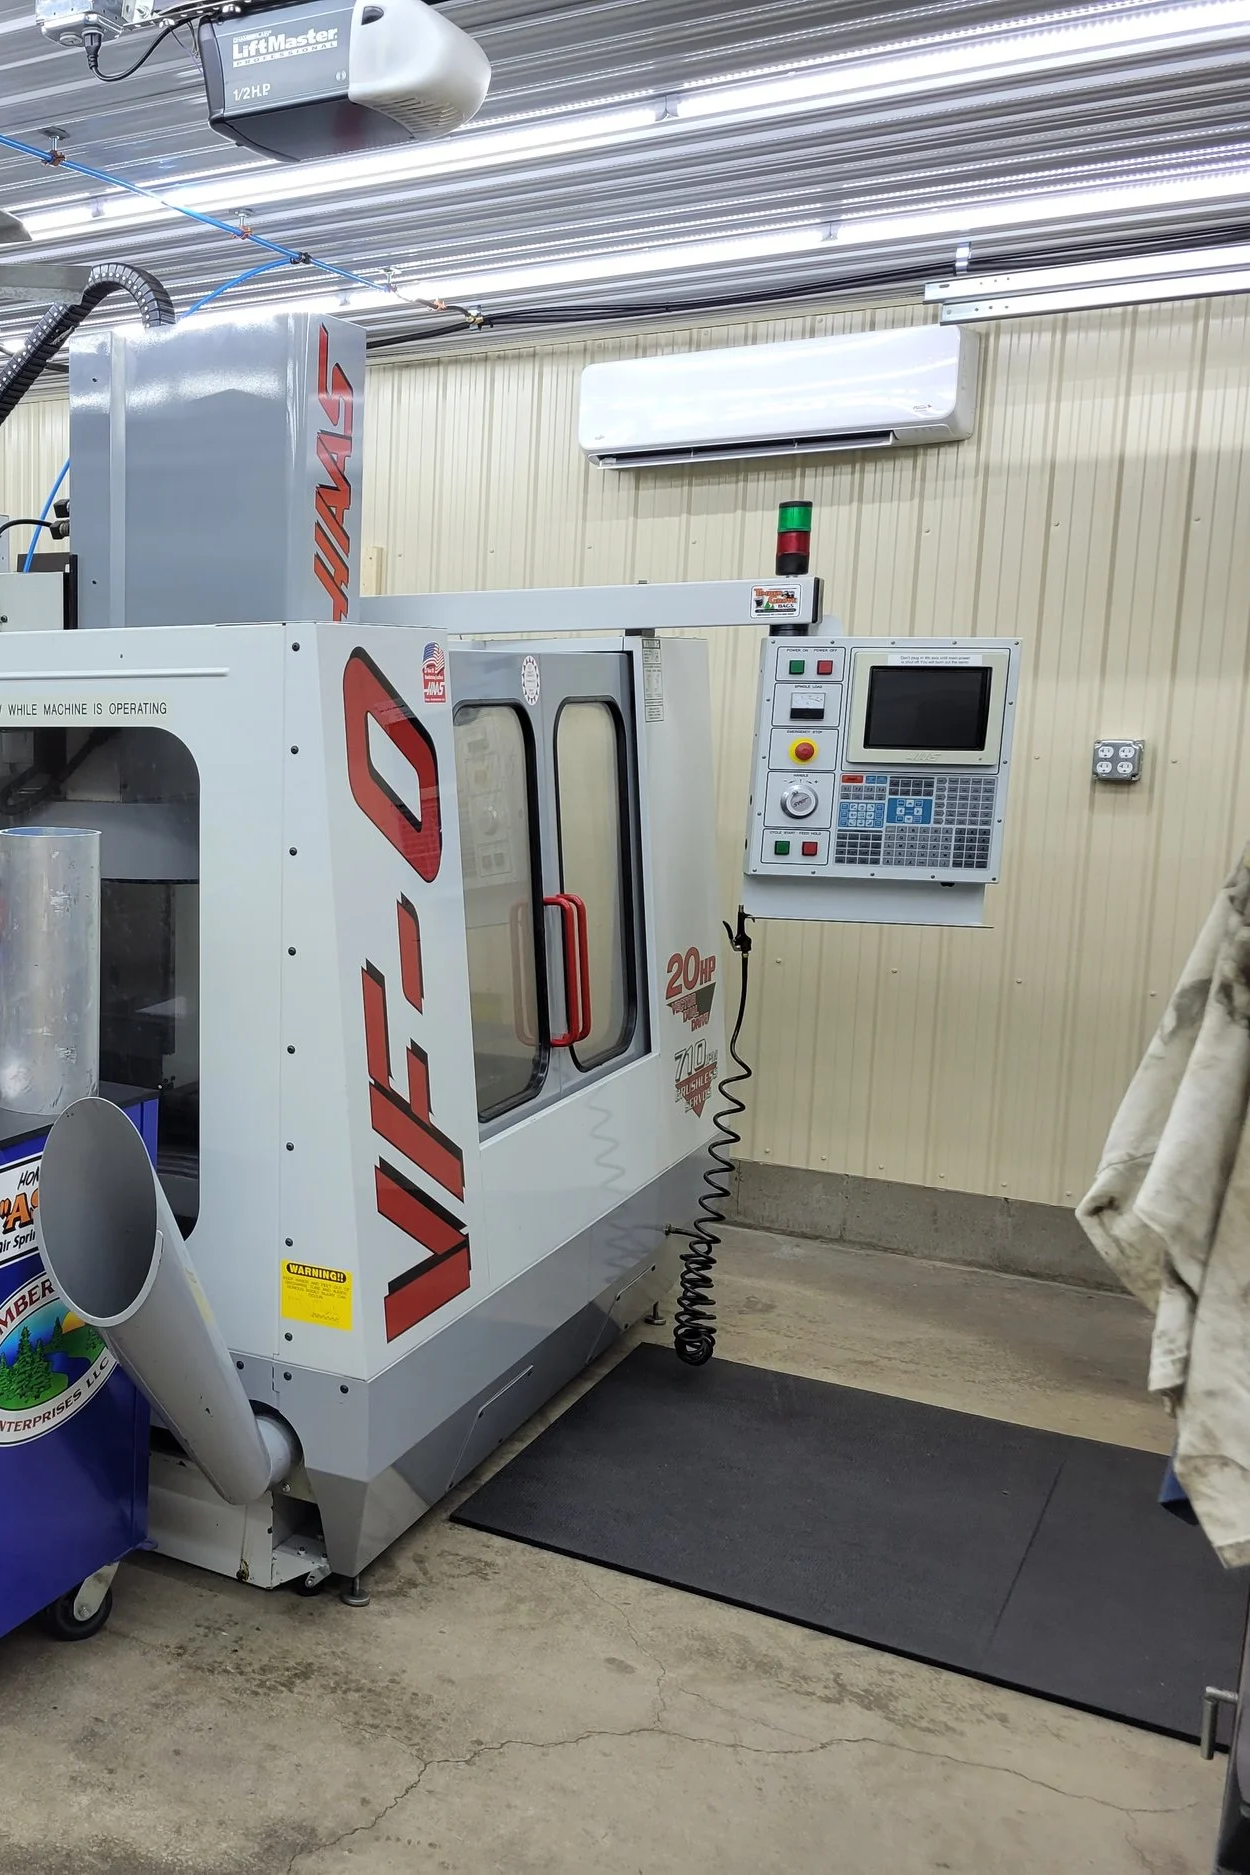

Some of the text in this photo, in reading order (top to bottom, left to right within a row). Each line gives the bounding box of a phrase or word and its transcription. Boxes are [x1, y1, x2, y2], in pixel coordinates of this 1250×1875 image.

[232, 28, 338, 60] LiftMaster
[236, 42, 335, 67] PROFESSIONAL
[233, 87, 250, 101] 1/2
[8, 703, 38, 716] WHILE
[43, 703, 88, 715] MACHINE
[93, 702, 103, 715] IS
[108, 702, 167, 715] OPERATING
[288, 1263, 344, 1283] WARNING!!
[86, 1355, 110, 1389] LLC
